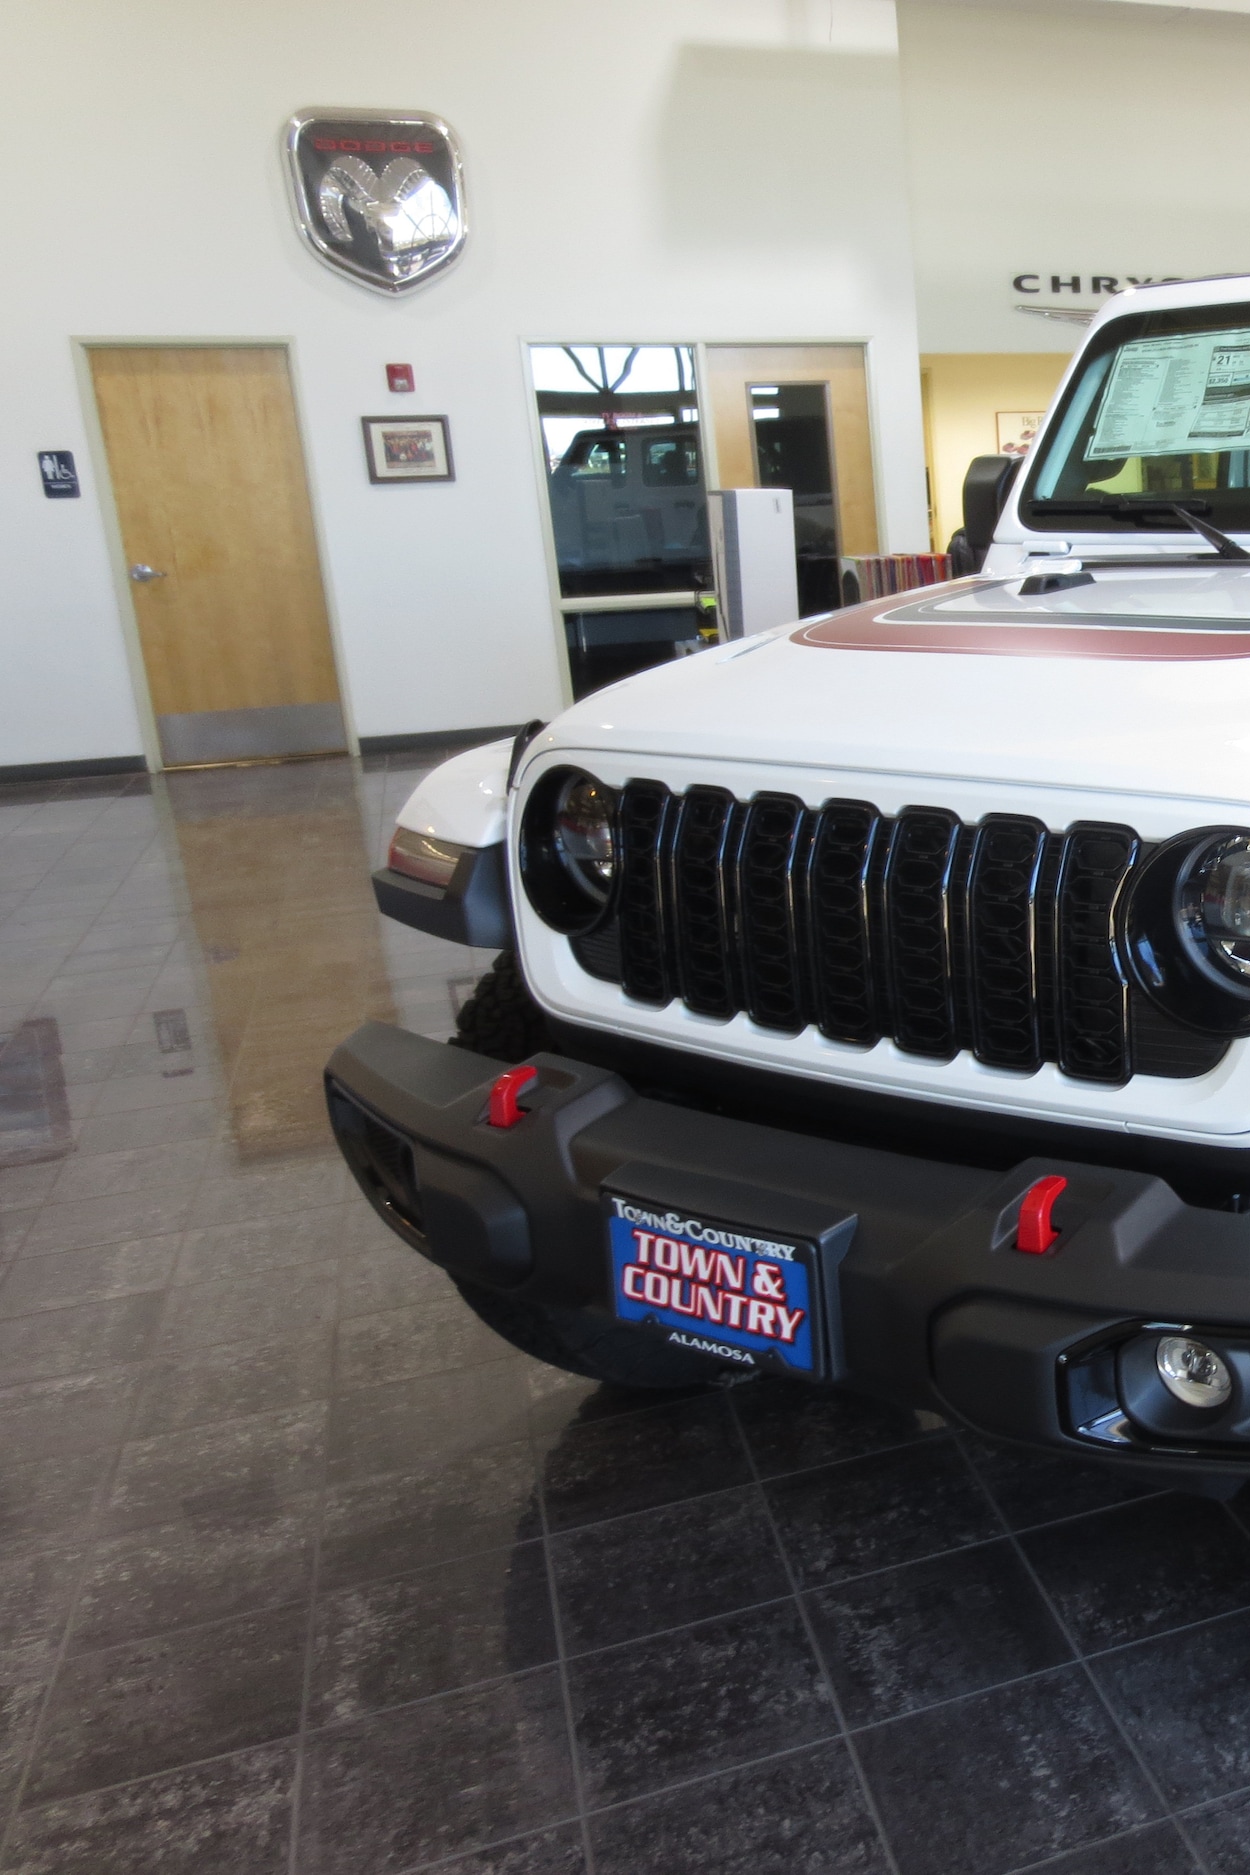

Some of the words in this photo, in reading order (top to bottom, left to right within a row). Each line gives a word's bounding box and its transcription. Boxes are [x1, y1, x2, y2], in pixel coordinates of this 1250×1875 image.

[314, 138, 434, 154] DODGE
[1012, 274, 1184, 295] CHRY
[1216, 355, 1231, 365] 21
[632, 1228, 745, 1291] TOWN
[752, 1260, 787, 1301] &
[622, 1264, 805, 1343] COUNTRY
[668, 1331, 756, 1365] ALAMOSA
